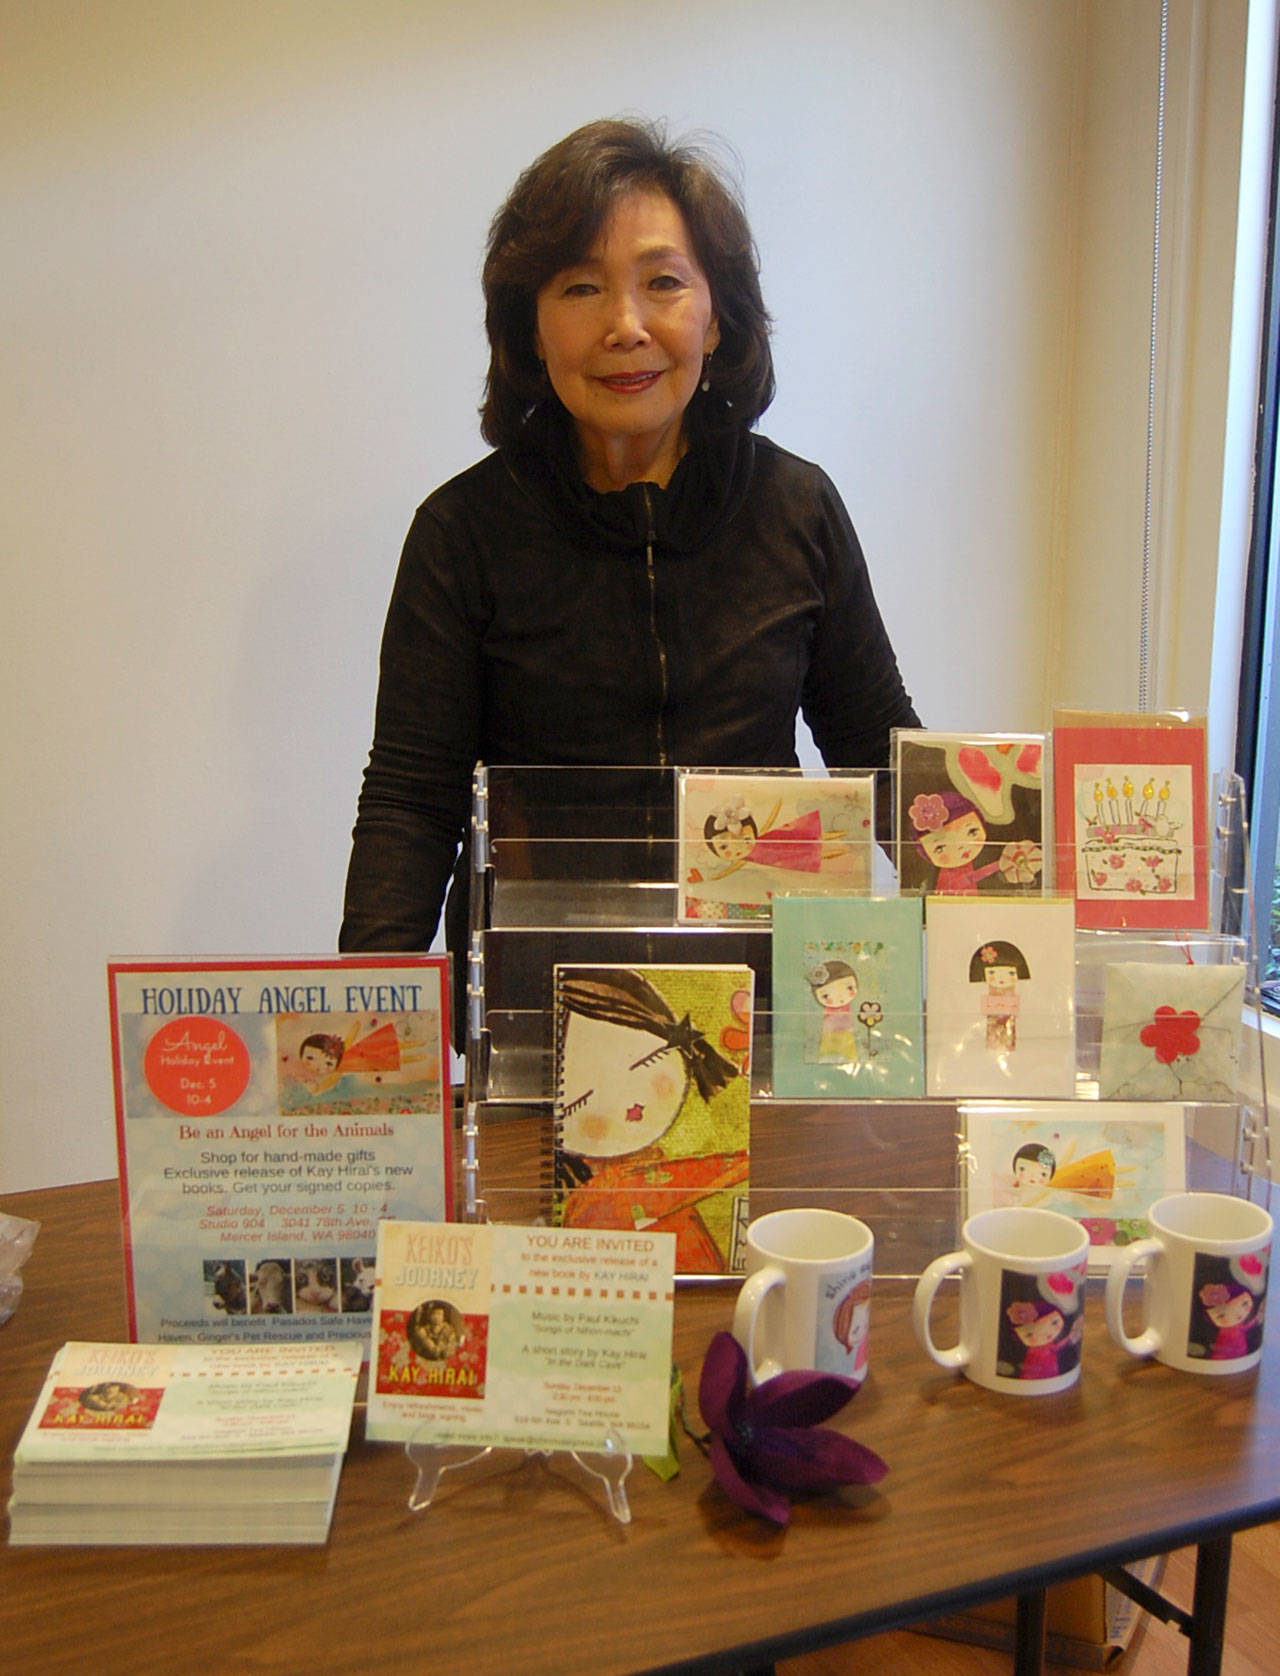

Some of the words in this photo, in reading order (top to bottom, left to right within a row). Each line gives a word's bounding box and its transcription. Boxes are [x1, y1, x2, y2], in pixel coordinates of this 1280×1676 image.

[141, 987, 242, 1015] HOLIDAY
[258, 986, 331, 1013] ANGEL
[345, 985, 422, 1012] EVENT
[162, 1029, 228, 1065] Angel
[160, 1055, 200, 1066] Holiday
[209, 1078, 216, 1089] 5
[187, 1094, 212, 1104] 10-4
[179, 1125, 200, 1140] Be
[206, 1127, 224, 1139] an
[229, 1125, 271, 1142] Angel
[277, 1124, 299, 1138] for
[304, 1124, 328, 1137] the
[332, 1122, 394, 1138] Animals
[200, 1151, 237, 1167] Shop
[241, 1150, 259, 1163] for
[263, 1149, 343, 1163] hand-made
[347, 1149, 376, 1165] gifts
[164, 1167, 229, 1179] Exclusive
[234, 1166, 284, 1178] release
[289, 1165, 302, 1177] of
[306, 1165, 333, 1180] Kay
[338, 1163, 380, 1177] Hirai's
[385, 1165, 413, 1176] new
[182, 1182, 229, 1195] books.
[233, 1181, 258, 1194] Get
[262, 1183, 292, 1197] your
[296, 1180, 342, 1196] signed
[347, 1180, 396, 1195] copies.
[206, 1205, 264, 1218] Saturday,
[269, 1203, 332, 1216] December
[337, 1203, 345, 1215] 5
[353, 1203, 369, 1214] 10
[380, 1202, 389, 1213] 4
[200, 1218, 238, 1230] Studio
[242, 1217, 265, 1229] 904
[220, 1230, 264, 1243] Mercer
[312, 1229, 333, 1241] WA
[527, 1235, 559, 1248] YOU
[562, 1236, 592, 1249] ARE
[596, 1238, 655, 1252] INVITED
[533, 1253, 548, 1262] the
[551, 1253, 597, 1264] exclusive
[601, 1255, 636, 1266] release
[393, 1266, 480, 1291] JOURNEY
[552, 1269, 575, 1279] book
[594, 1271, 615, 1281] KAY
[619, 1272, 649, 1282] HIRAI
[161, 1317, 210, 1329] Proceeds
[232, 1316, 266, 1328] benefit
[198, 1331, 241, 1345] Ginger's
[243, 1331, 261, 1342] Pet
[263, 1330, 302, 1342] Rescue
[305, 1329, 325, 1341] and
[388, 1365, 421, 1385] KAY
[428, 1366, 476, 1386] HIRAI
[53, 1414, 86, 1424] KAY
[95, 1413, 145, 1424] HIRAI
